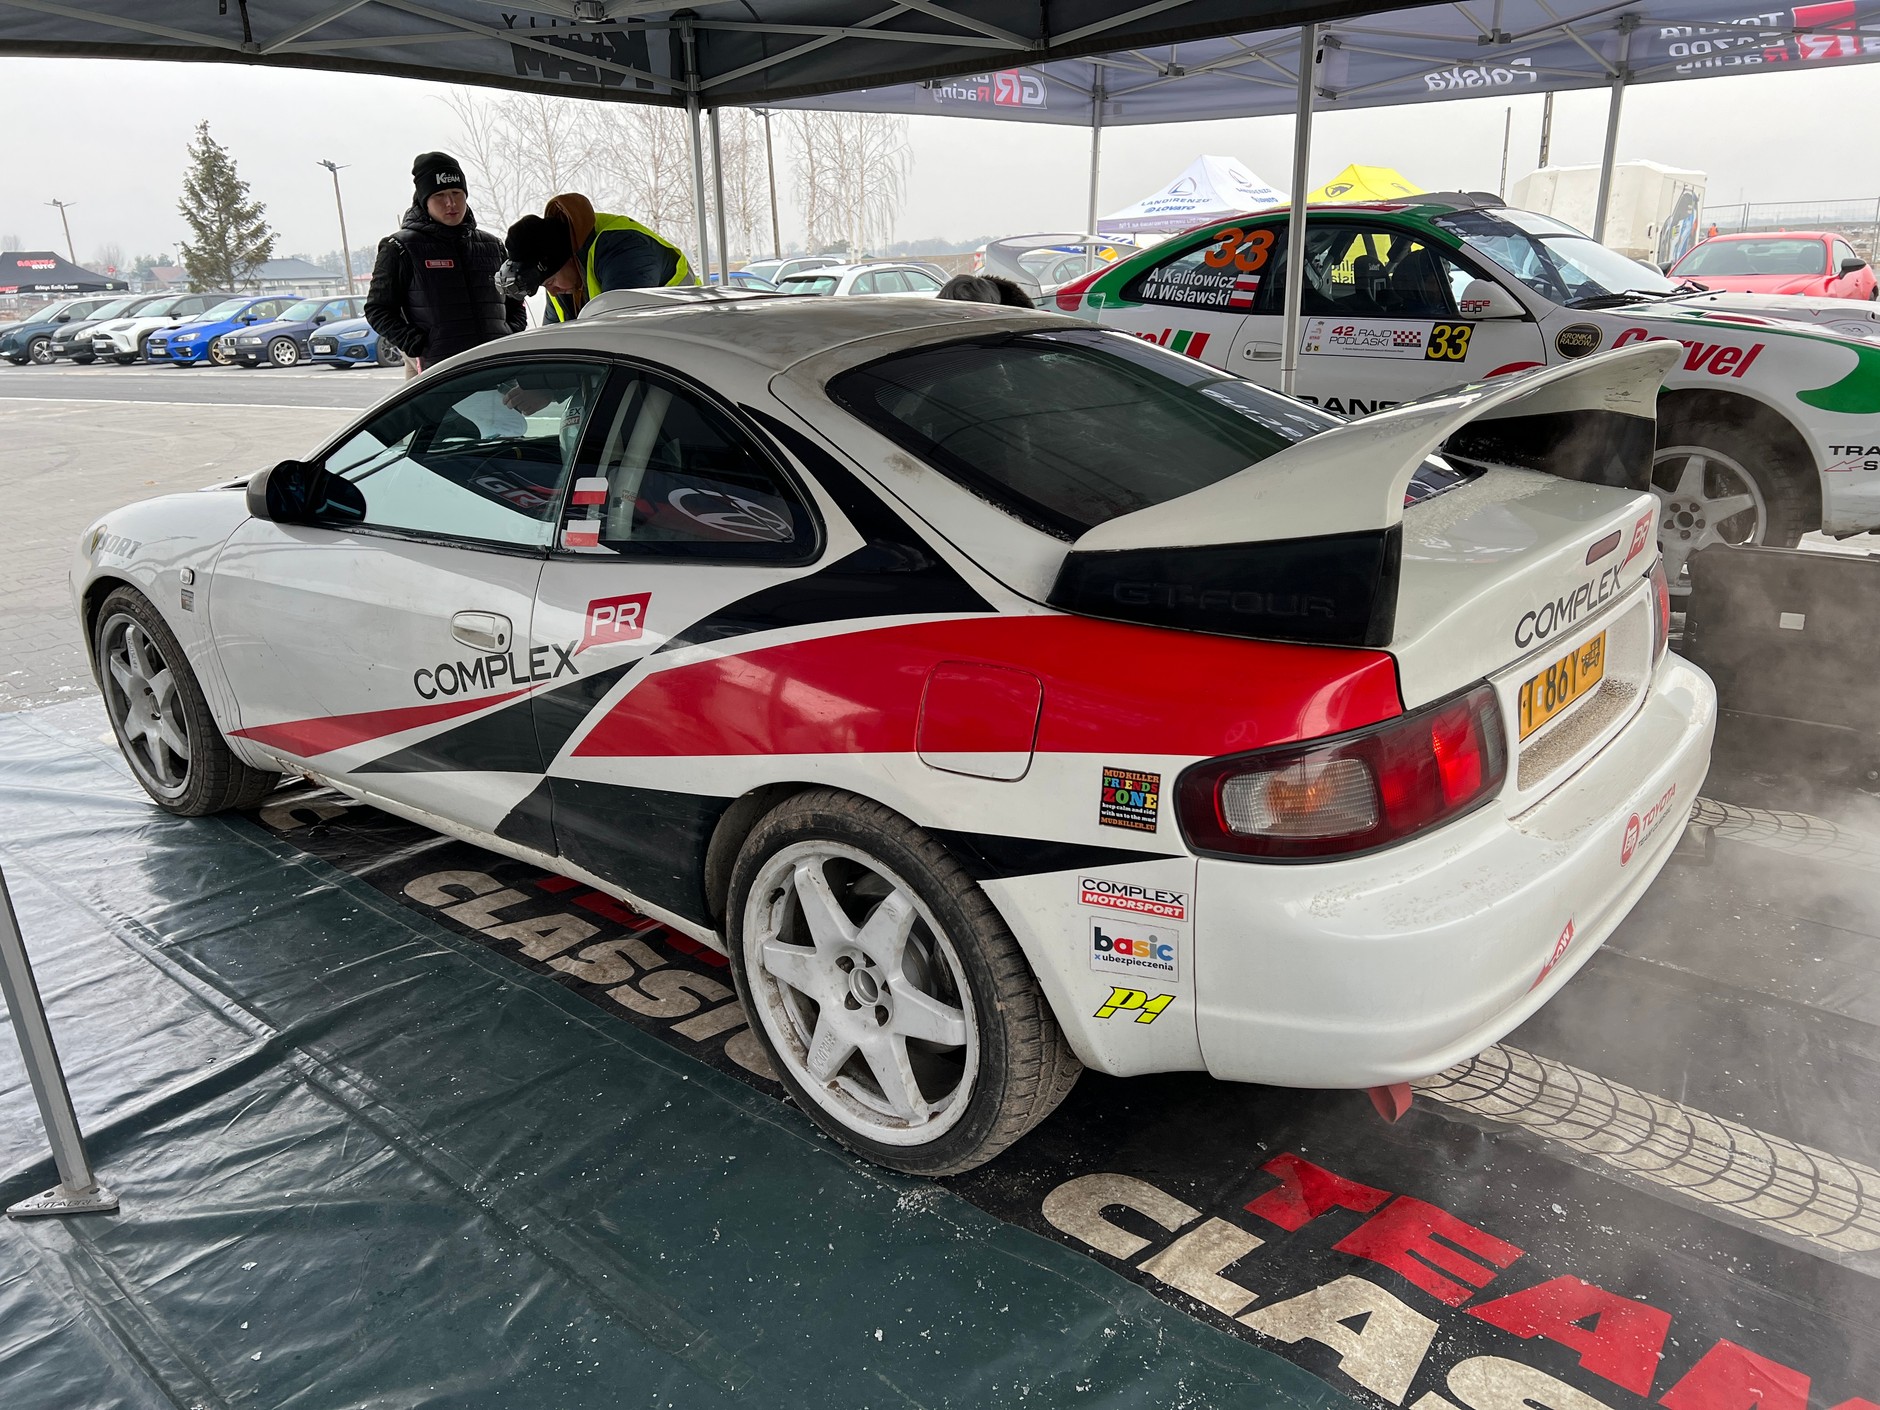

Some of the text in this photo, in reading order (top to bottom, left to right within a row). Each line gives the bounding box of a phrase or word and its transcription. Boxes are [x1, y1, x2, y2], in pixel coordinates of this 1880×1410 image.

[1204, 227, 1275, 272] 33
[1147, 267, 1237, 289] A.Kalitowicz
[1141, 283, 1232, 306] M.Wisławski
[1329, 336, 1389, 347] PODLASKI
[1331, 325, 1357, 337] 42.
[1358, 329, 1393, 338] RAJD
[1427, 324, 1472, 360] 33
[1610, 327, 1766, 378] Crvel
[1514, 558, 1626, 649] COMPLEX
[591, 602, 641, 637] PR
[413, 640, 580, 700] COMPLEX
[1543, 647, 1581, 714] 86Y
[1103, 769, 1159, 783] MUDKILLER
[1103, 777, 1158, 794] FRIENDS
[1103, 787, 1158, 810] ZONE
[1642, 783, 1676, 831] TOYOTA
[1082, 878, 1184, 906] COMPLEX
[1084, 893, 1182, 917] MOTORSPORT
[1094, 926, 1174, 961] basic
[1102, 955, 1174, 971] ubezpieczenia
[1093, 985, 1177, 1024] P1
